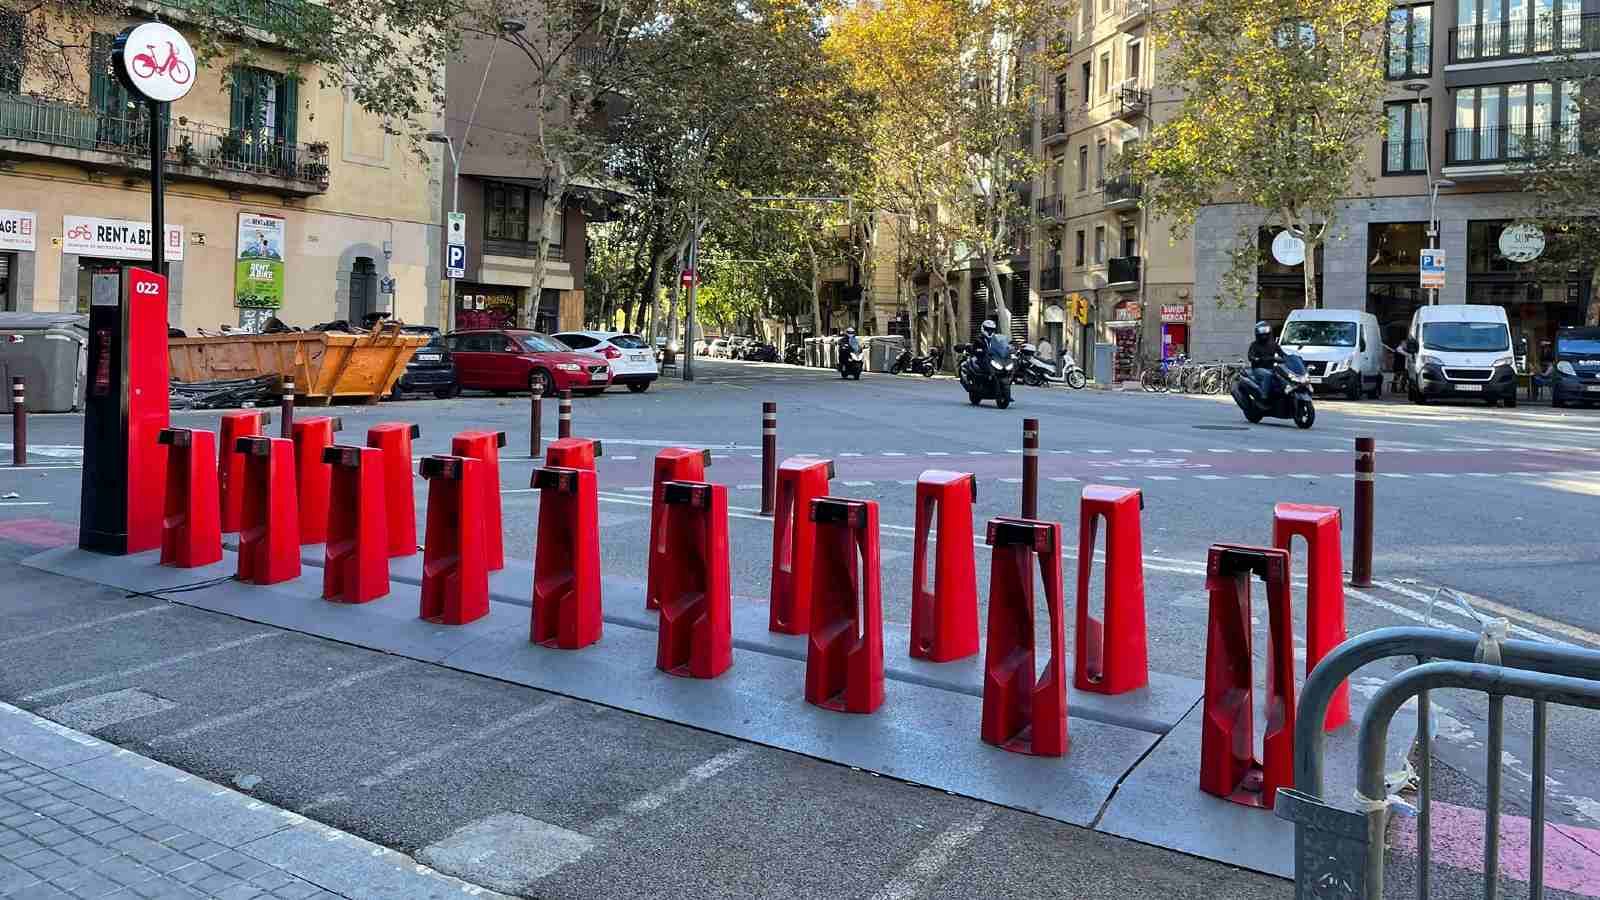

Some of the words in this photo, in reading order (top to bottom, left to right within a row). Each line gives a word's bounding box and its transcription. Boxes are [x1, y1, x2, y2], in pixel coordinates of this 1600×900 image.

[97, 225, 128, 244] RENT
[130, 234, 136, 244] A
[450, 247, 462, 267] P
[1423, 256, 1432, 267] P
[136, 281, 159, 295] 022
